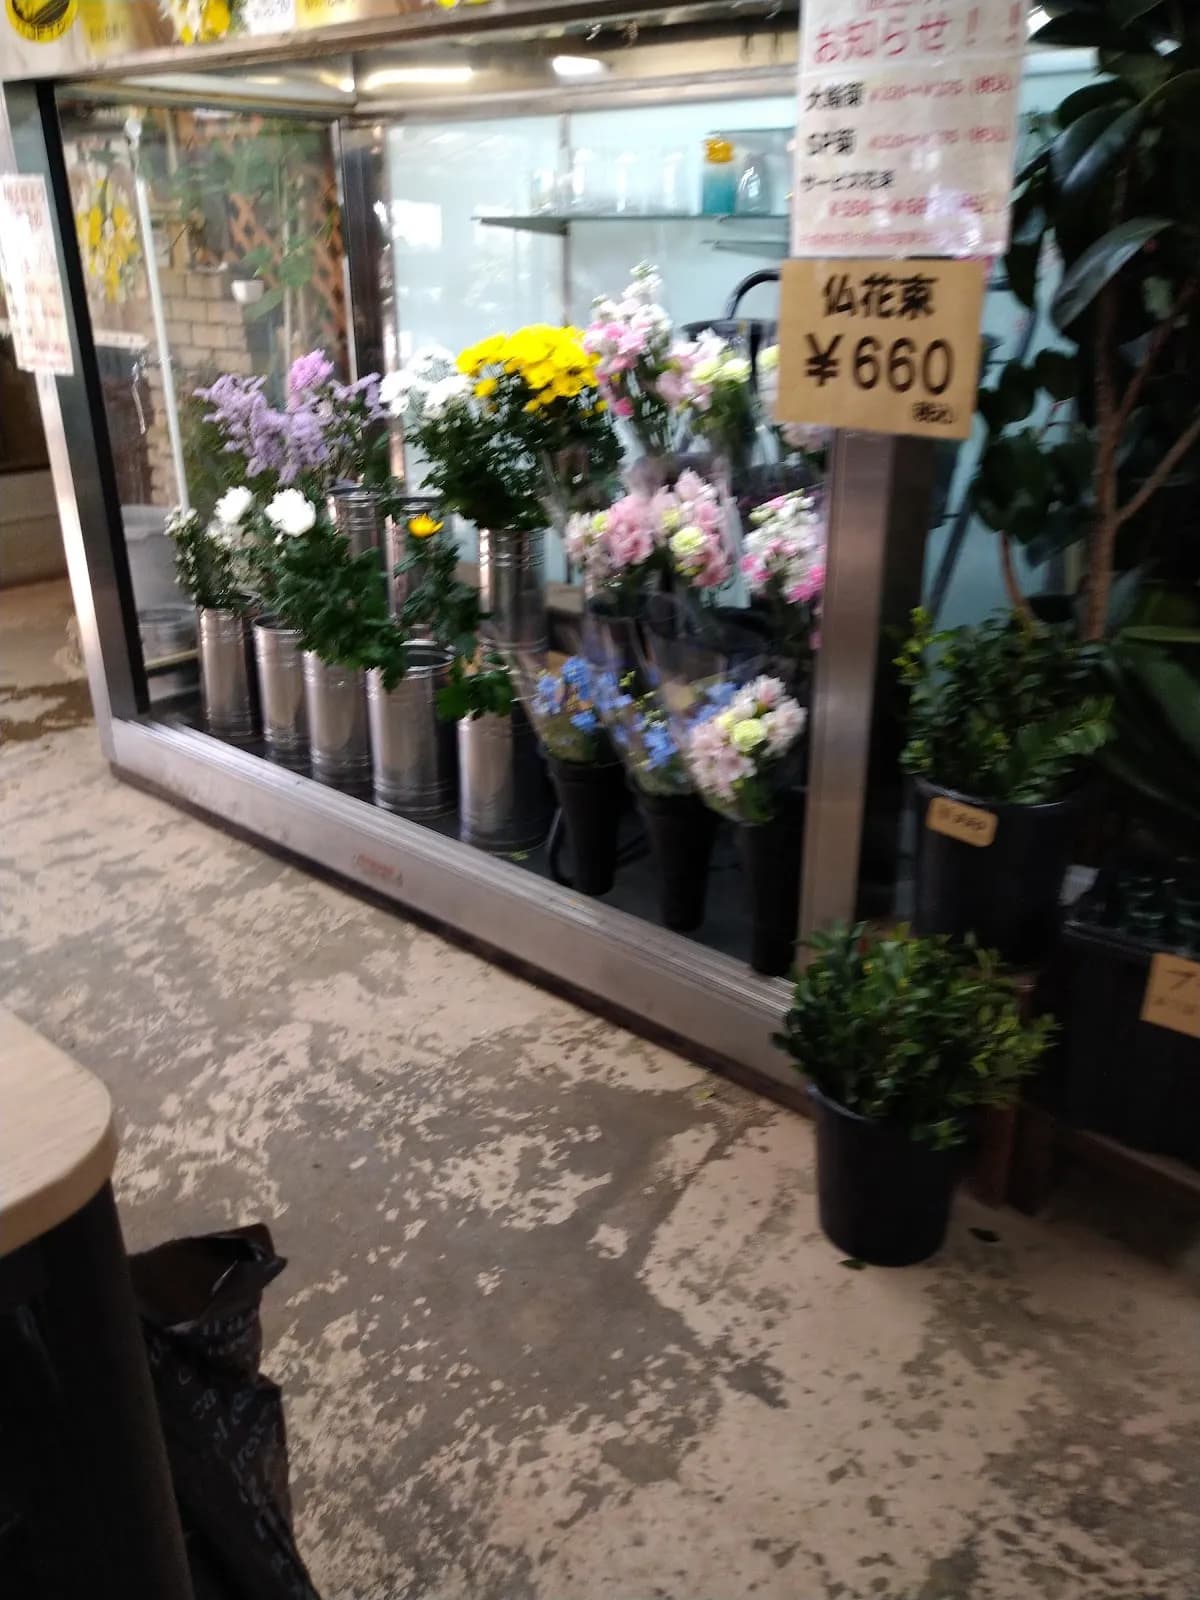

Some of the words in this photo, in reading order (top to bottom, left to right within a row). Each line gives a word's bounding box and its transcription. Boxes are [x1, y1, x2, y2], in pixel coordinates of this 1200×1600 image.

[822, 272, 939, 319] 仏花束
[804, 333, 955, 396] ¥660
